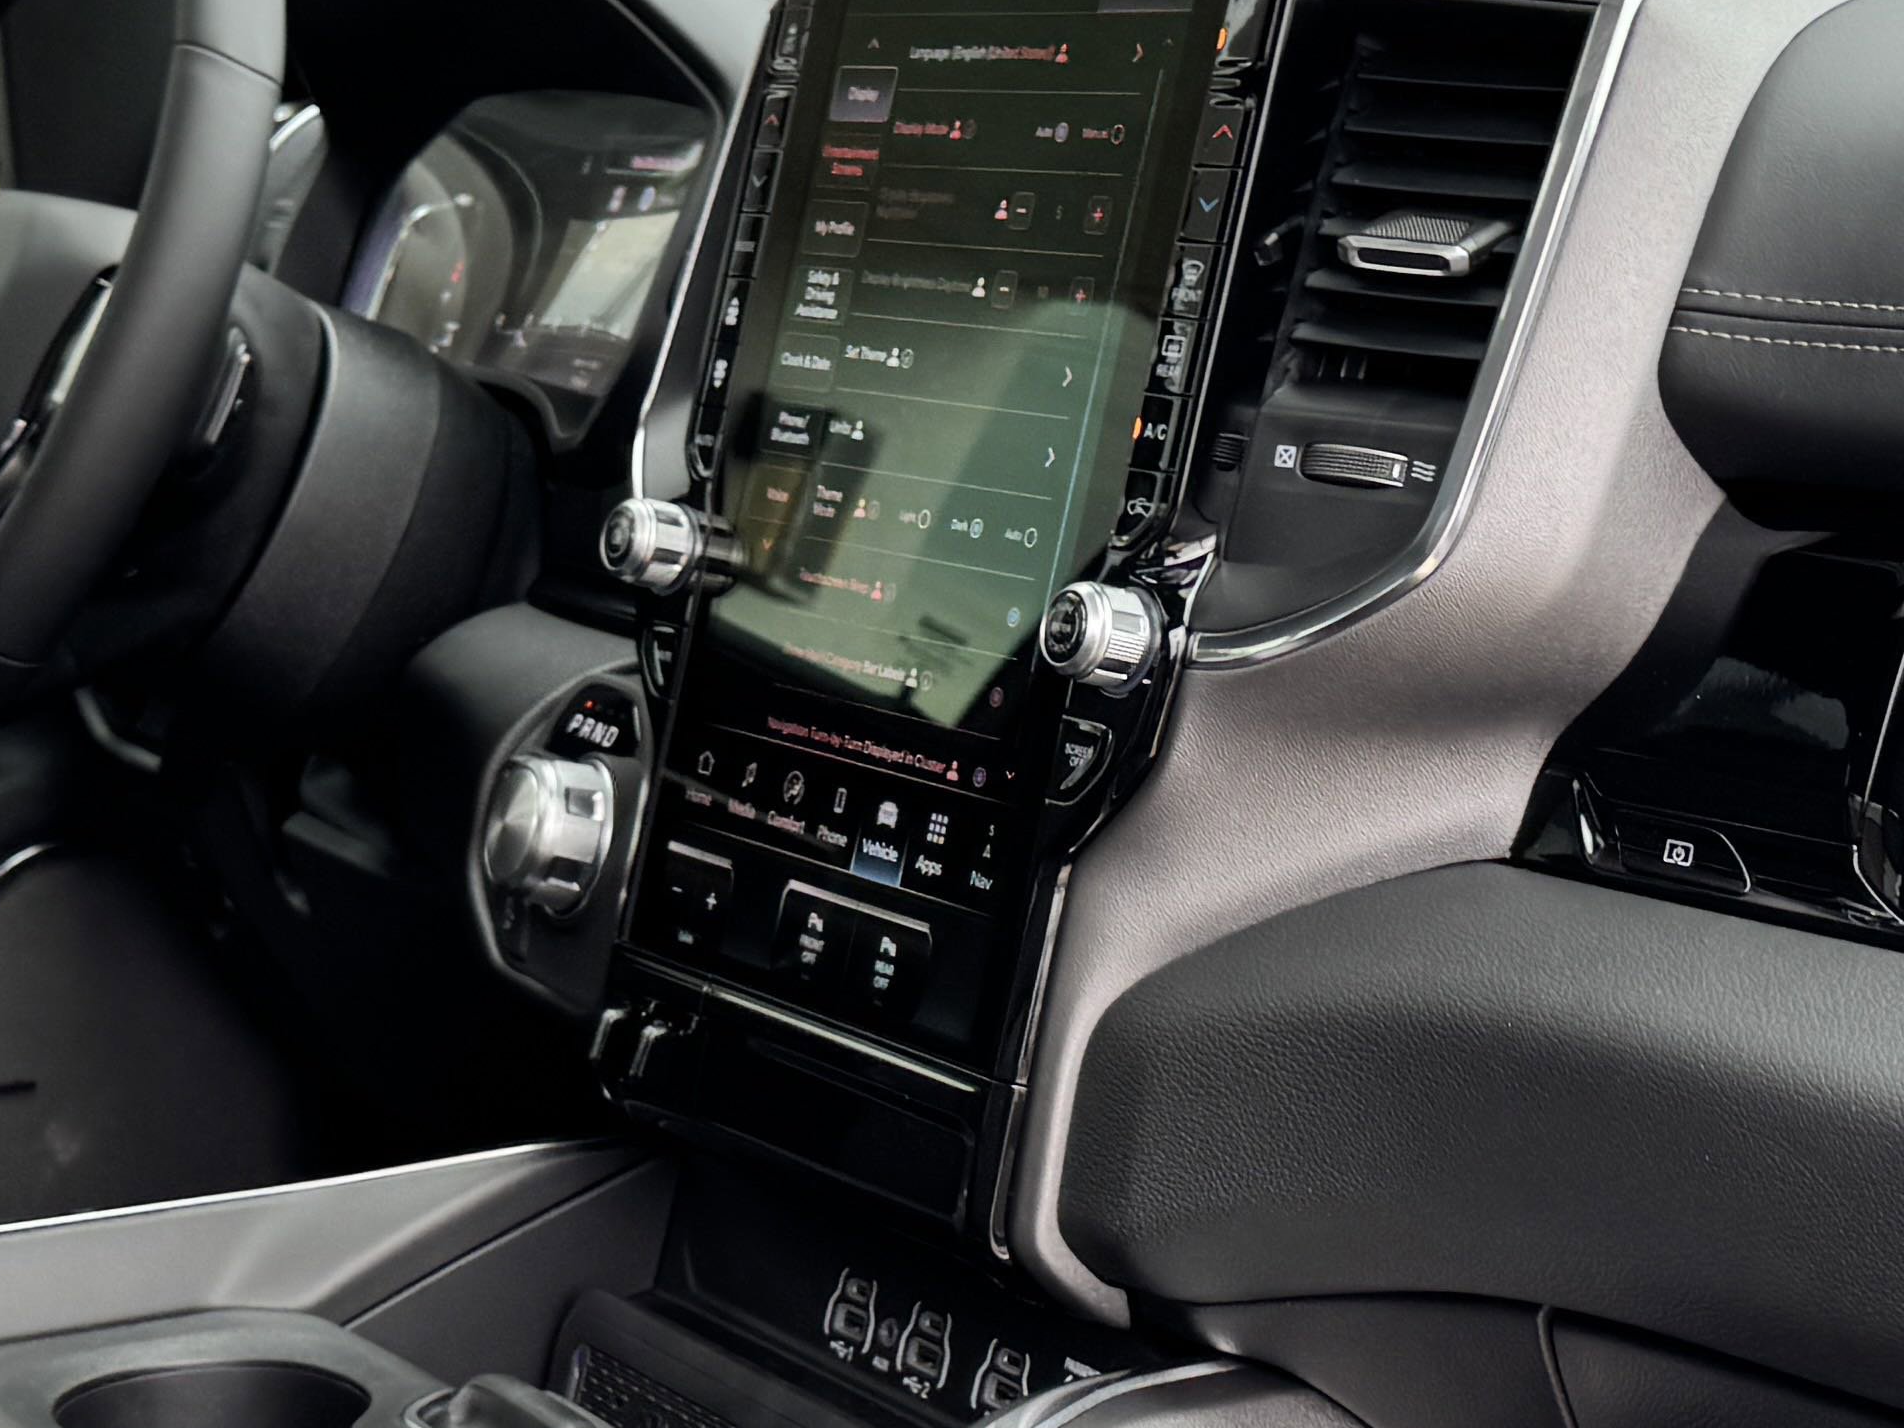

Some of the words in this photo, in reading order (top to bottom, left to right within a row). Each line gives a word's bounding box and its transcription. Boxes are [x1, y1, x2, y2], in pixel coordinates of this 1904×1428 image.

[1144, 422, 1168, 441] A/C
[565, 713, 619, 748] PRND
[862, 837, 899, 864] Vehicle
[915, 854, 943, 877] Apps
[969, 870, 994, 892] Nav
